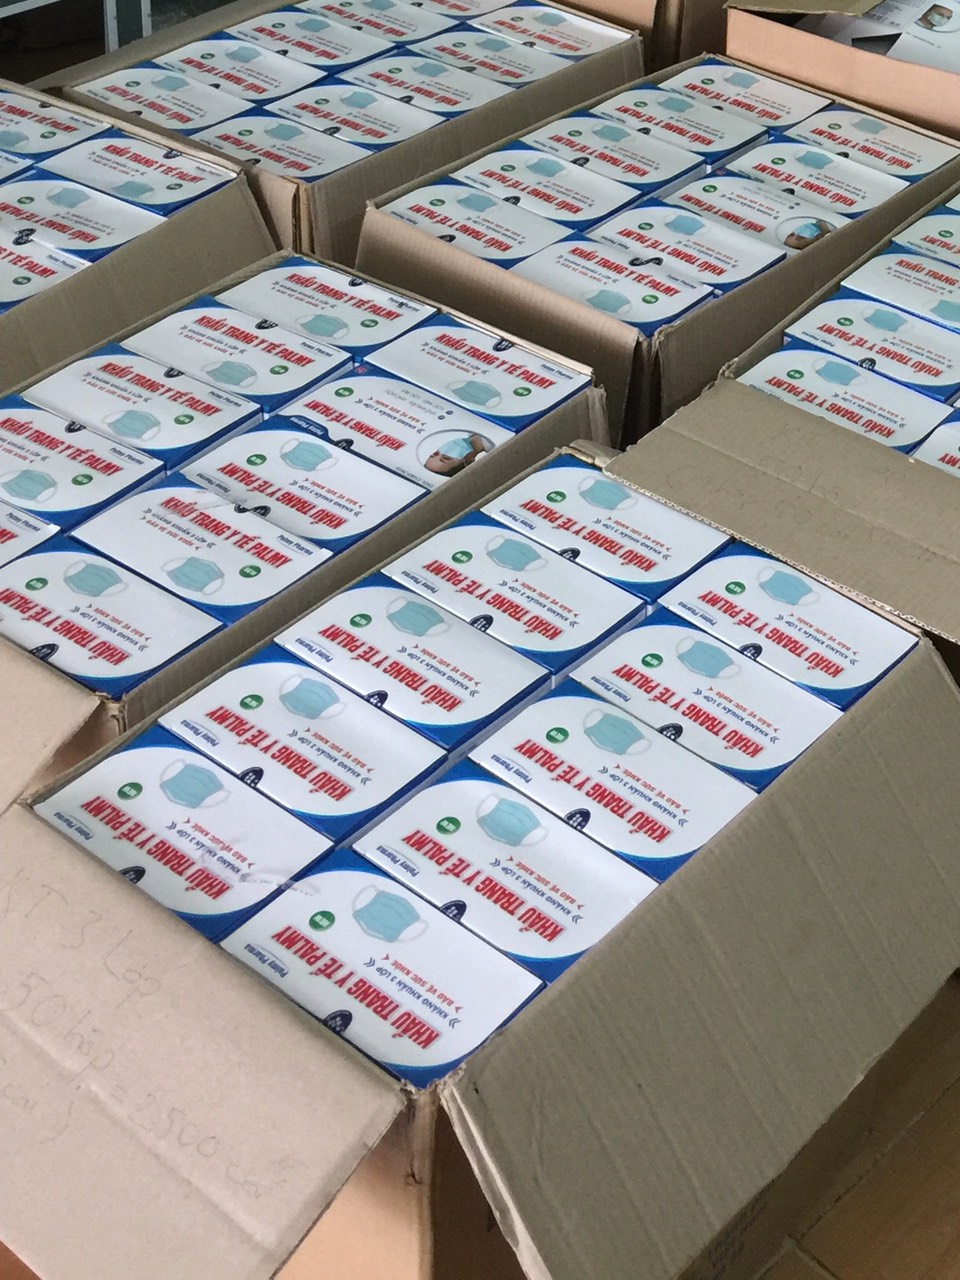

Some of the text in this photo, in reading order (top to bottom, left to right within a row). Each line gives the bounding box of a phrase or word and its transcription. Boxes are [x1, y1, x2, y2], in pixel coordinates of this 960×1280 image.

[312, 282, 349, 300] TRANG
[343, 295, 357, 303] Y
[363, 302, 404, 322] PALMY
[815, 322, 855, 342] PALMY
[221, 325, 260, 345] TRANG
[253, 338, 268, 347] Y
[273, 346, 316, 368] PALMY
[462, 345, 500, 365] TRANG
[495, 360, 509, 368] Y
[515, 368, 556, 390] PALMY
[865, 342, 877, 351] Y
[874, 345, 912, 366] TRANG
[216, 461, 261, 487] PALMY
[265, 486, 282, 497] Y
[274, 490, 316, 515] TRANG
[518, 497, 657, 572] KHẨU TRANG Y TẾ PALMY
[421, 558, 563, 641] KHẨU TRANG Y TẾ PALMY
[697, 588, 844, 678] KHẨU TRANG Y TẾ PALMY
[317, 622, 462, 712] KHẨU TRANG Y TẾ PALMY
[611, 661, 764, 758] KHẨU TRANG Y TẾ PALMY
[204, 703, 352, 802] KHẨU TRANG Y TẾ PALMY
[513, 736, 671, 844] KHẨU TRANG Y TẾ PALMY
[79, 793, 230, 900] KHẨU TRANG Y TẾ PALMY
[400, 826, 564, 942] KHẨU TRANG Y TẾ PALMY
[312, 912, 330, 927] NEW
[270, 922, 440, 1050] KHẨU TRANG Y TẾ PALMY
